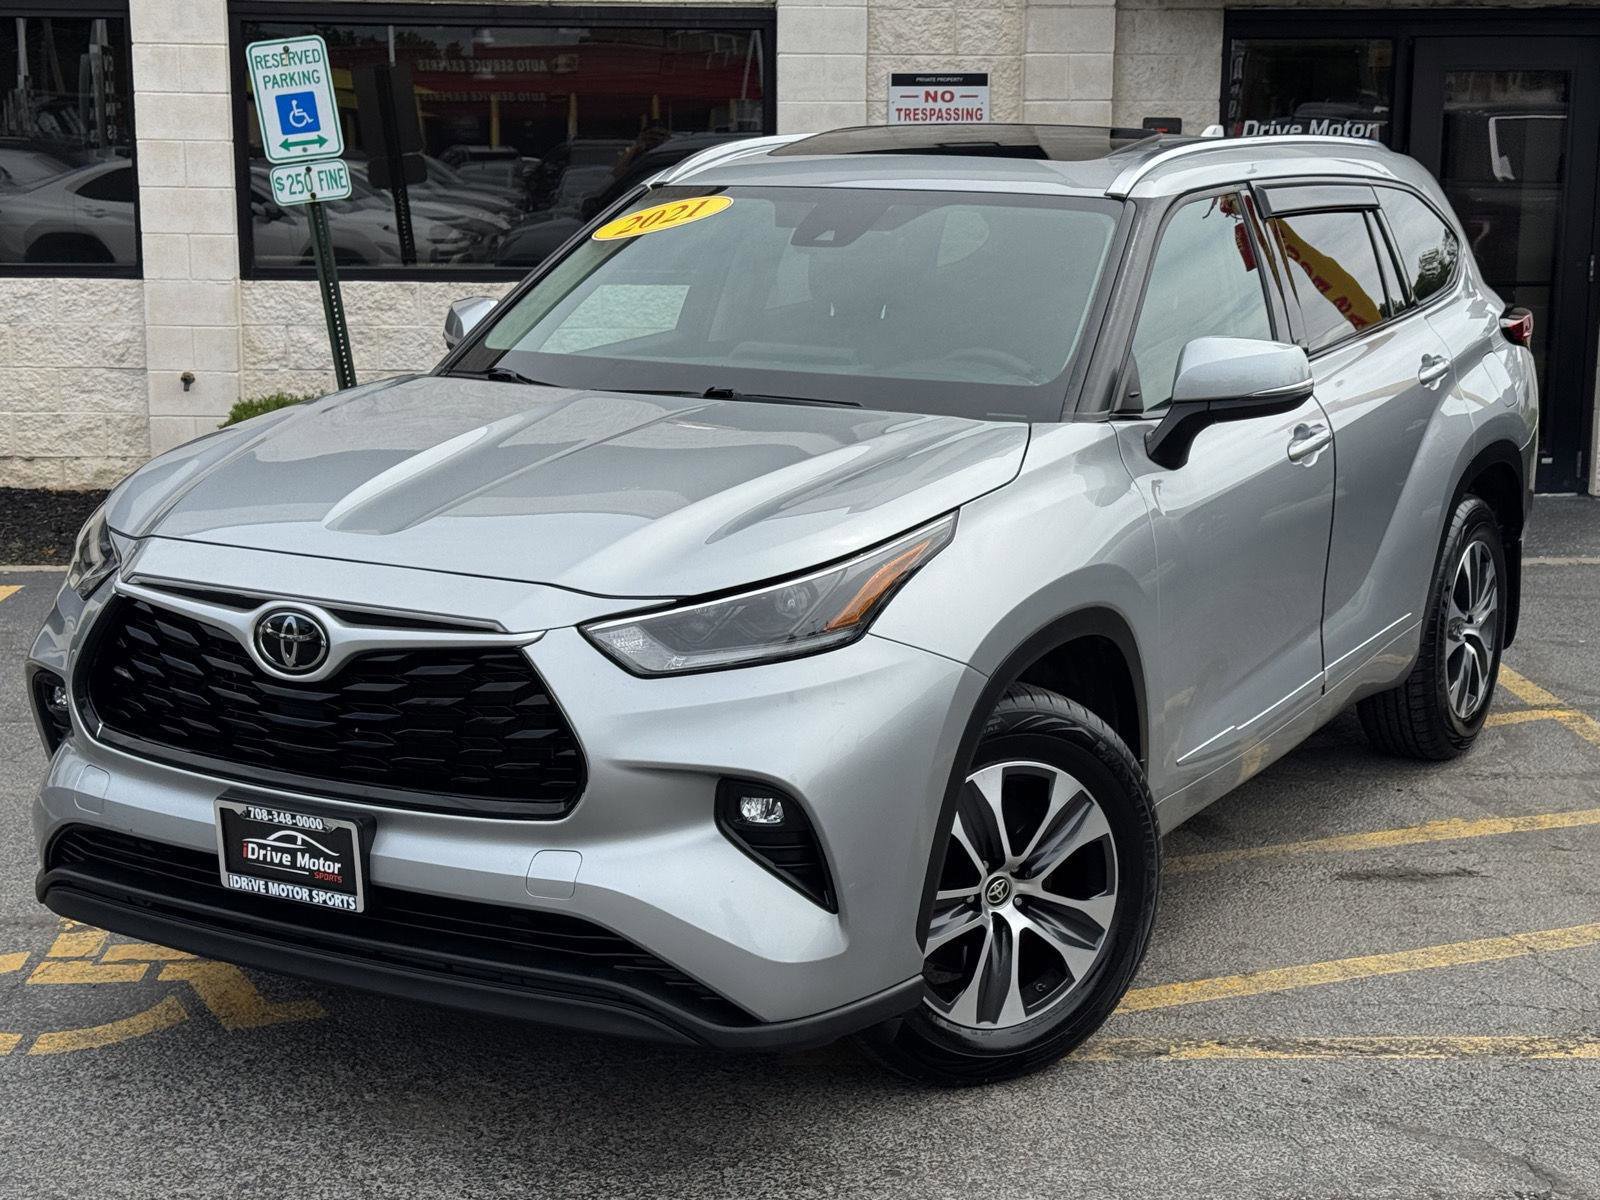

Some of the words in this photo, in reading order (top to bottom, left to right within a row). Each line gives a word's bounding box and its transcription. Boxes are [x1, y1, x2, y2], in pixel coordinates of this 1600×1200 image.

[254, 49, 321, 70] RESERVED
[262, 69, 321, 90] PARKING
[924, 90, 955, 103] NO
[896, 107, 984, 122] TRESPASSING
[1309, 119, 1378, 137] Motor
[275, 171, 313, 195] $250
[317, 168, 347, 191] FINE
[614, 199, 710, 235] 2021
[248, 807, 323, 830] 708-348-0000
[242, 842, 292, 865] iDrive
[296, 852, 342, 874] Motor
[313, 871, 343, 884] SPORTS
[267, 881, 310, 902] MOTOR
[311, 890, 356, 910] SPORTS
